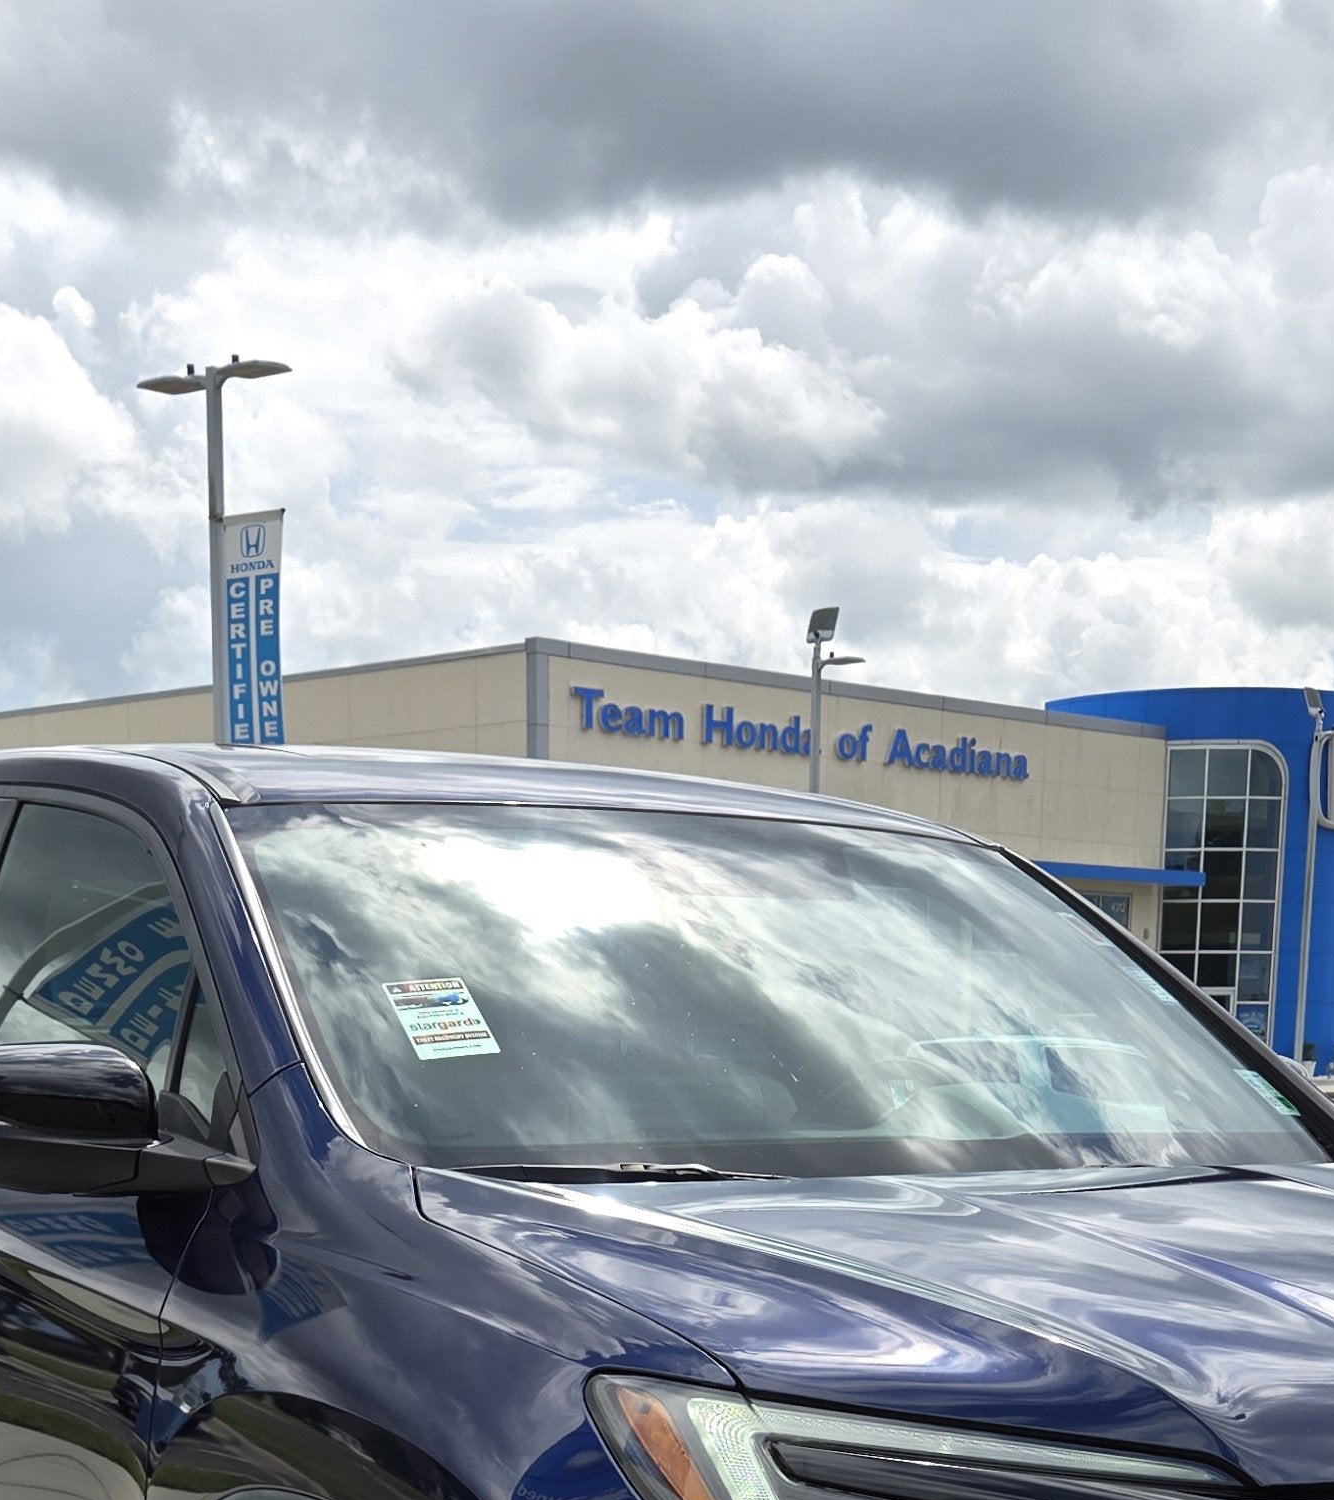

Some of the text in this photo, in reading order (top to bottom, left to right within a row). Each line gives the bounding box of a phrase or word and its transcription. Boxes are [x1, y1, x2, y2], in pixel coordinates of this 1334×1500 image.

[231, 560, 274, 573] HONDA
[228, 582, 250, 740] CERTIFIE
[259, 578, 280, 740] PRE OWNE
[571, 687, 684, 741] Team
[836, 723, 873, 762] of
[886, 728, 1030, 781] Acadiana
[409, 981, 461, 992] ATTENTION
